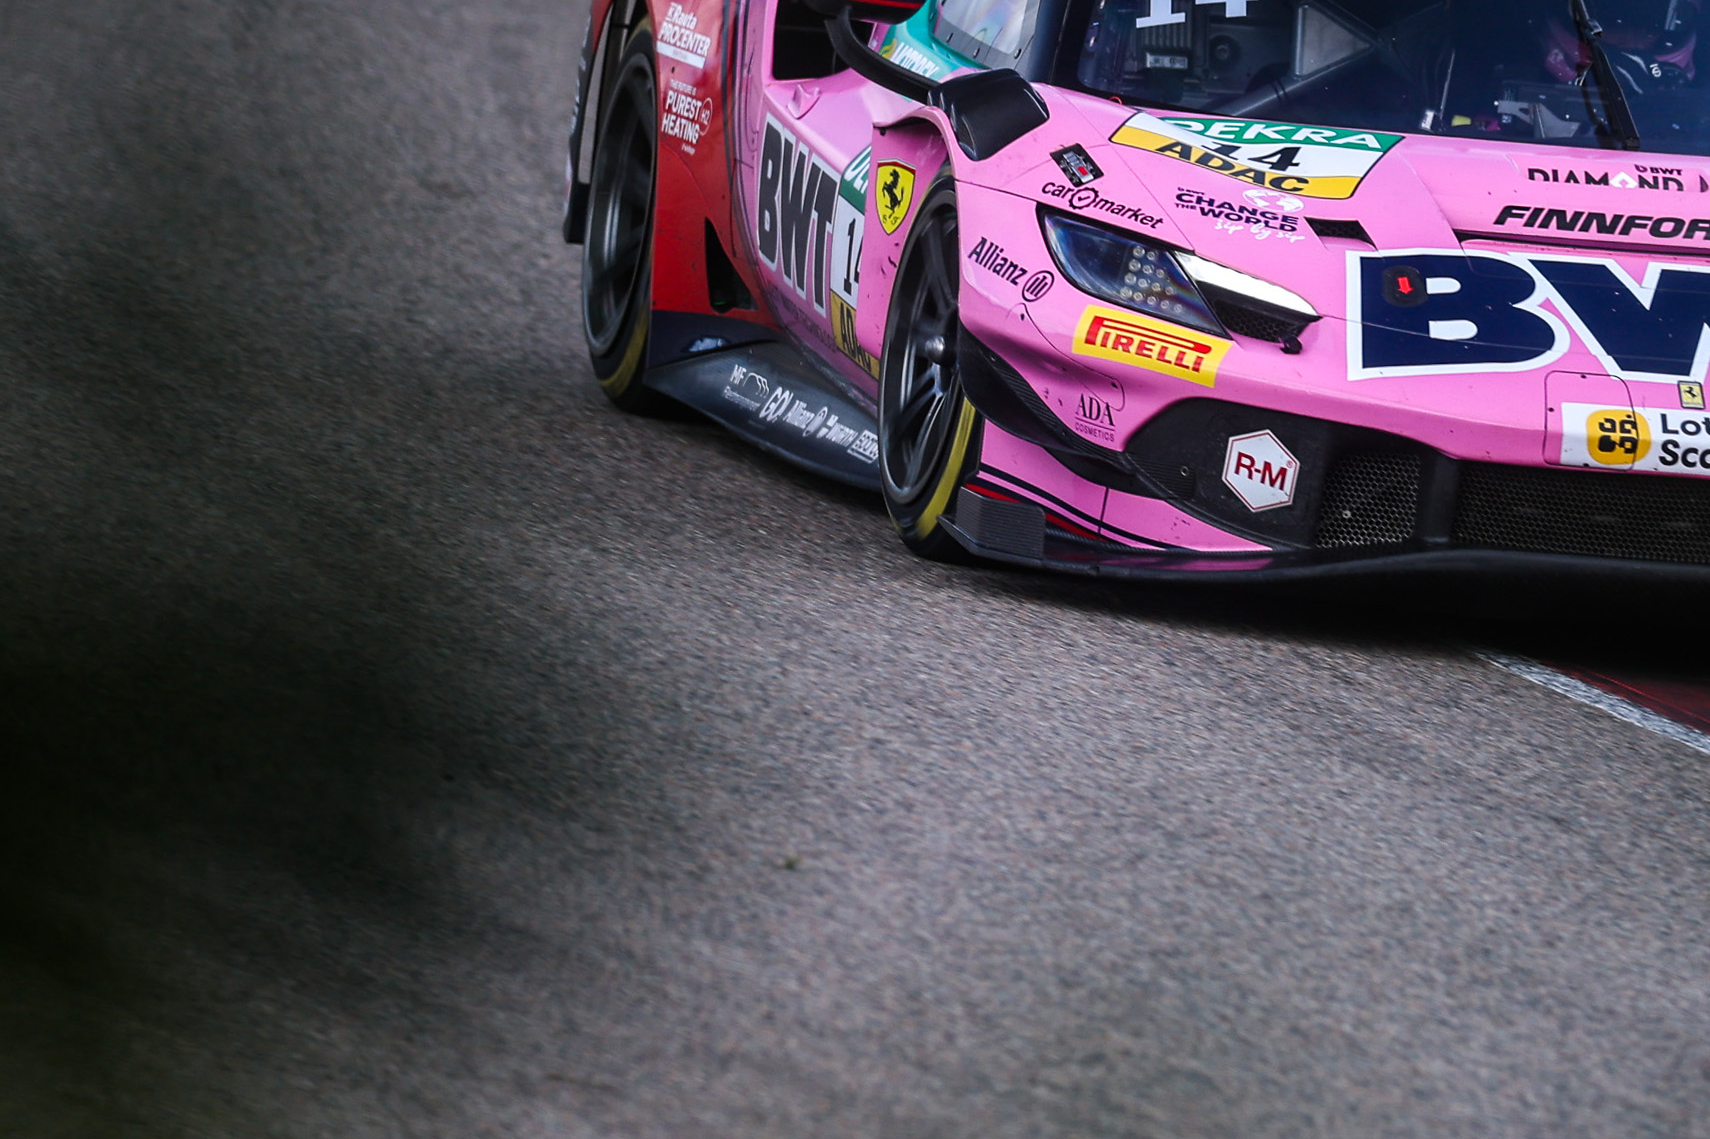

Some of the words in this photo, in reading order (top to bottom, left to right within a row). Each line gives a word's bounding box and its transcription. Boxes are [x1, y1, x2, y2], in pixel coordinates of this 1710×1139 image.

[658, 21, 711, 57] PROCENTER
[666, 90, 702, 120] PUREST
[661, 112, 700, 144] HEATING
[1154, 141, 1309, 192] ADAC
[1650, 166, 1684, 176] BWT
[758, 113, 839, 317] BWT
[1175, 193, 1299, 225] CHANGE
[1200, 206, 1298, 232] WORLD
[968, 236, 1028, 287] Allianz
[1084, 315, 1212, 373] PIRELLI
[1075, 393, 1115, 427] ADA
[1075, 421, 1114, 442] COSMETICS
